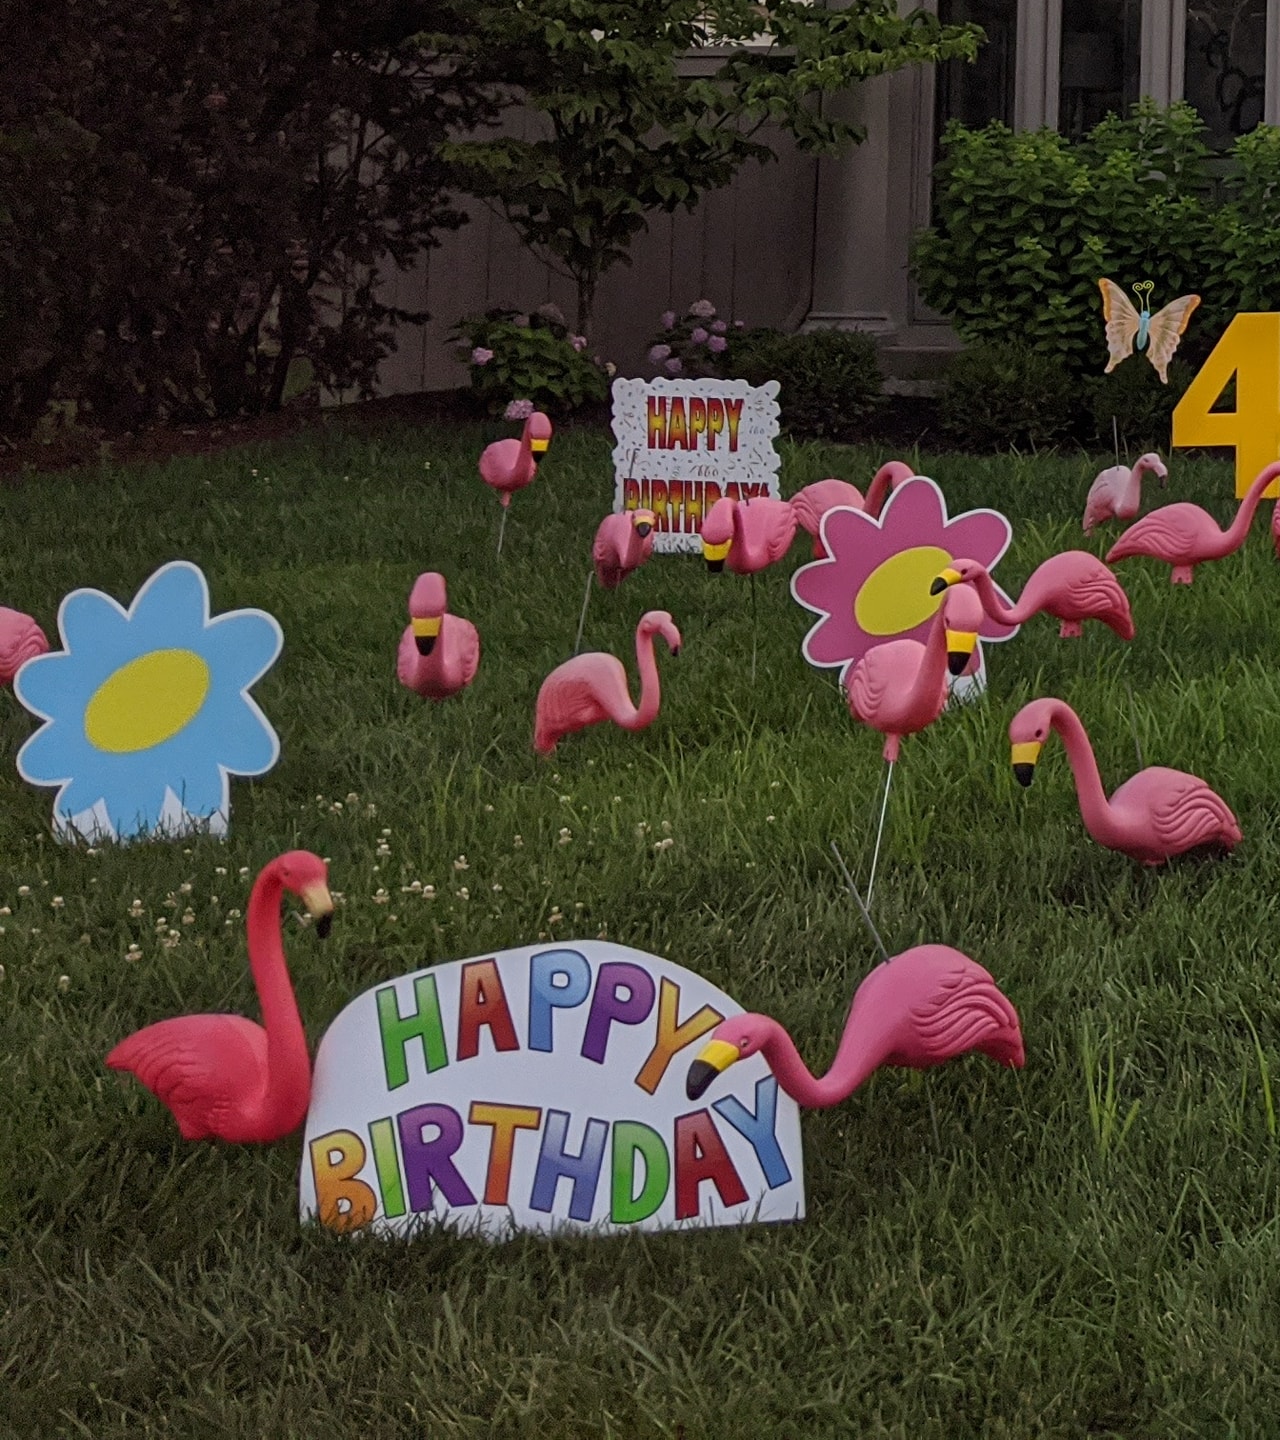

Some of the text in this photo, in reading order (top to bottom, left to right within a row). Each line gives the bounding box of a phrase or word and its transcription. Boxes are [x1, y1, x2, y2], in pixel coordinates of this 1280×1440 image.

[647, 396, 744, 452] HAPPY
[375, 948, 726, 1095] HAPPY
[309, 1074, 792, 1233] BIRTHDAY
